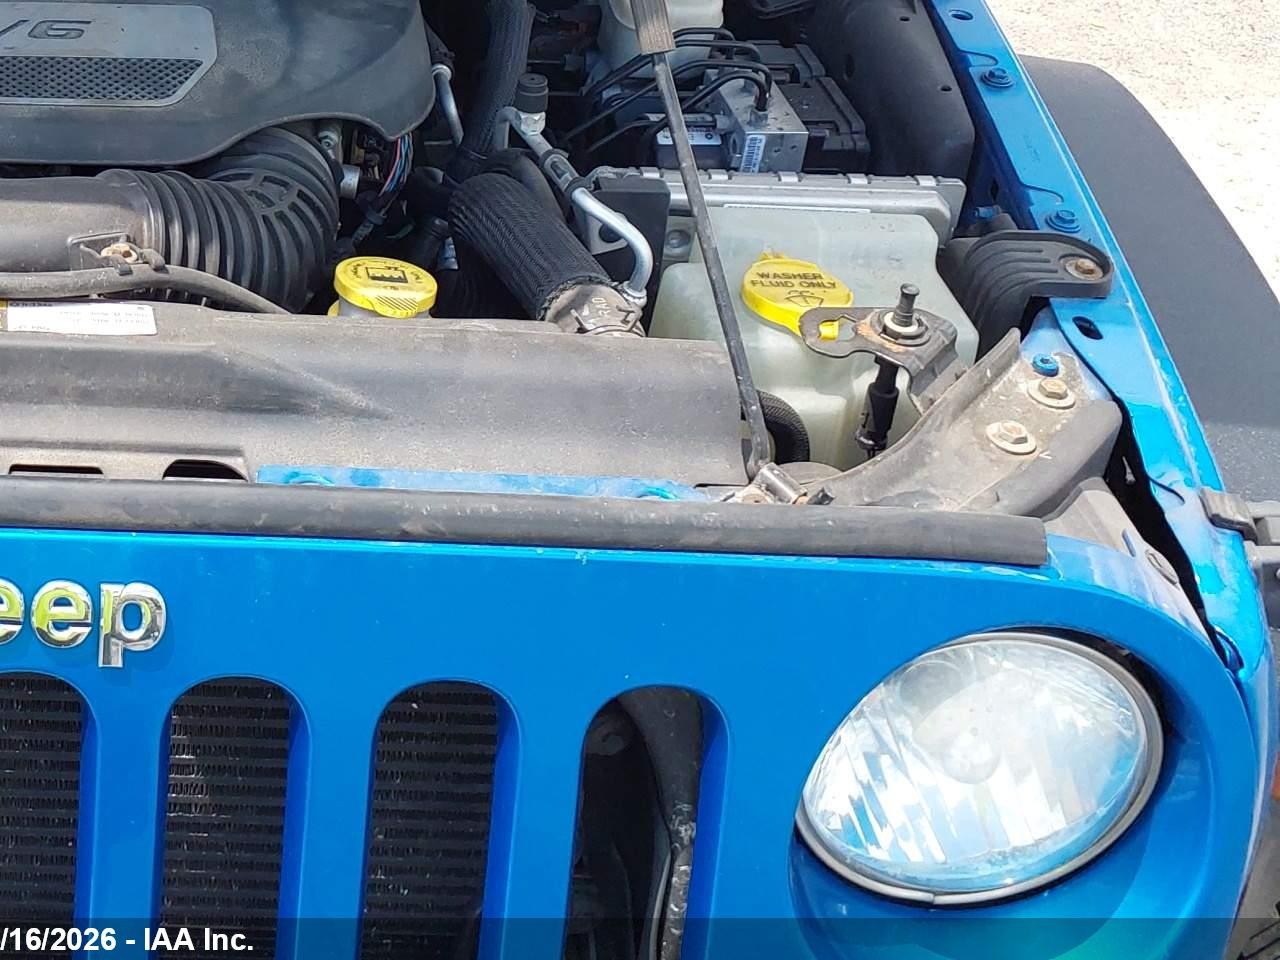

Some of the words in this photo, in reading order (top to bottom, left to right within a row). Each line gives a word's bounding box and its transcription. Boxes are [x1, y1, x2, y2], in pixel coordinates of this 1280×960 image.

[756, 271, 824, 280] WASHER
[750, 279, 796, 288] FLUID
[798, 280, 839, 290] ONLY
